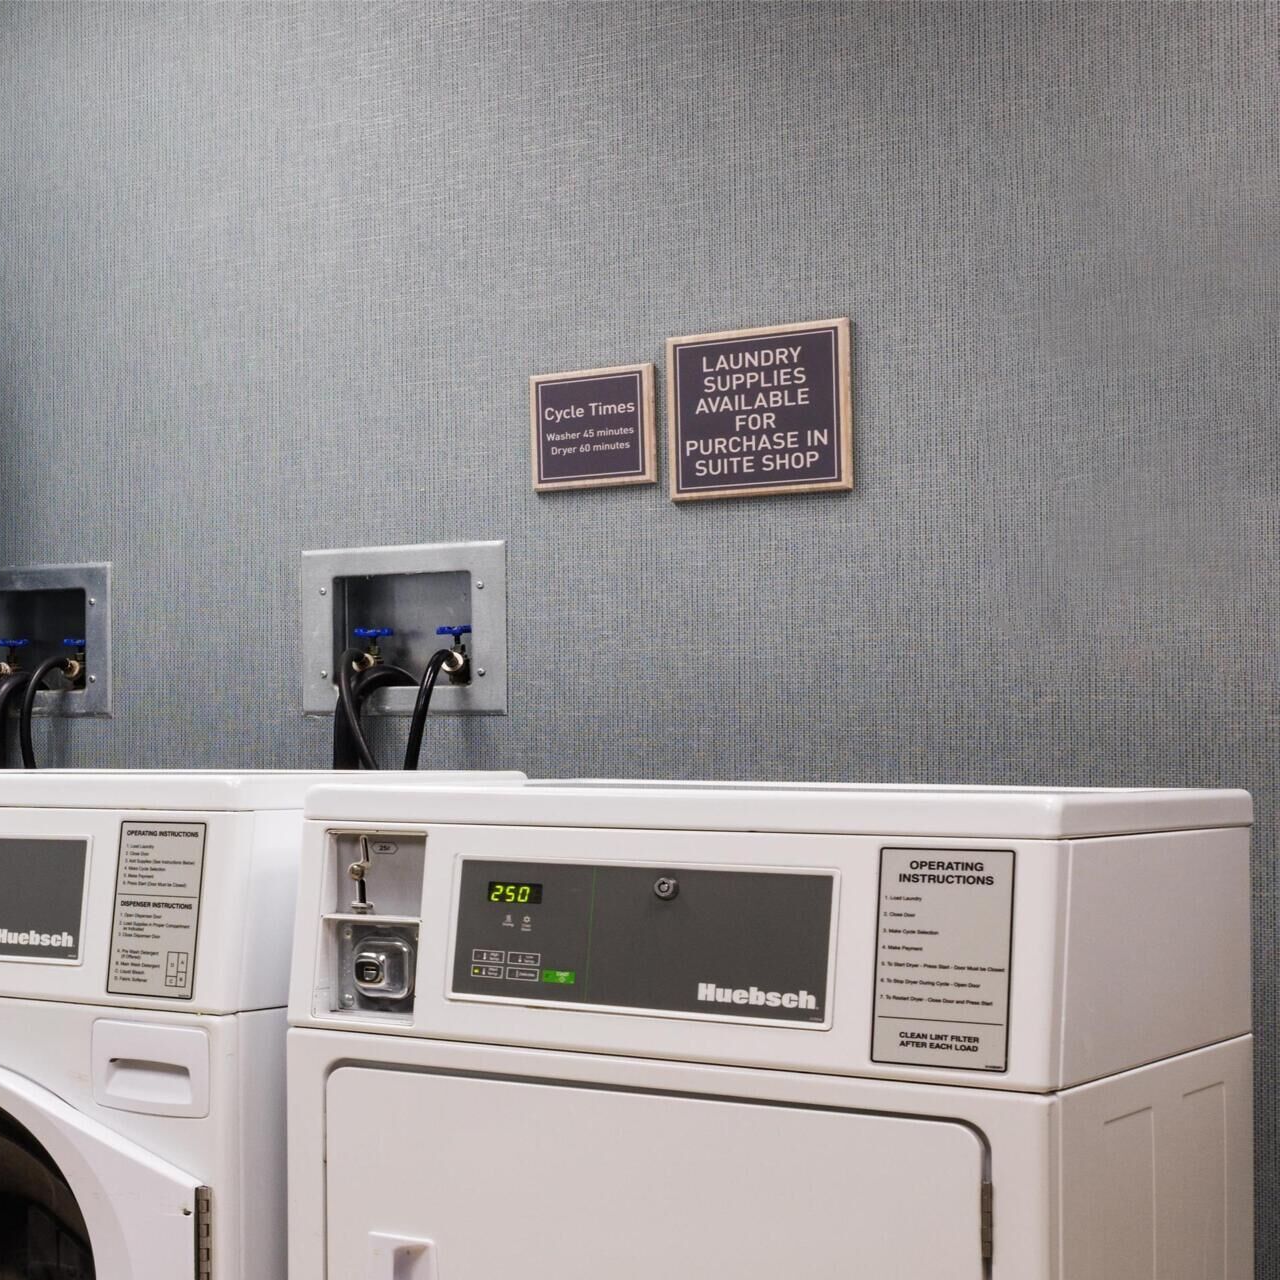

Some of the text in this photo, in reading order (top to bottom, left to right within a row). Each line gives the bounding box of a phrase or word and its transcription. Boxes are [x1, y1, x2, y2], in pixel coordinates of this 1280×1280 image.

[703, 346, 802, 372] LAUNDRY
[704, 367, 806, 393] SUPPLIES
[695, 388, 810, 415] AVAILABLE
[545, 402, 635, 423] Cycle Times
[736, 413, 776, 432] FOR
[546, 427, 634, 442] Washer 45 minutes
[686, 429, 828, 456] PURCHASE IN
[551, 442, 631, 456] Dryer 60 minutes
[696, 452, 819, 476] SUITE SHOP
[910, 861, 984, 871] OPERATING
[899, 874, 994, 885] INSTRUCTIONS
[491, 885, 530, 902] 250
[152, 902, 192, 910] INSTRUCTIONS
[698, 982, 816, 1010] Huebsch
[899, 1032, 927, 1040] CLEAN
[951, 1035, 979, 1043] FILTER
[899, 1040, 978, 1052] AFTER EACH LOAD
